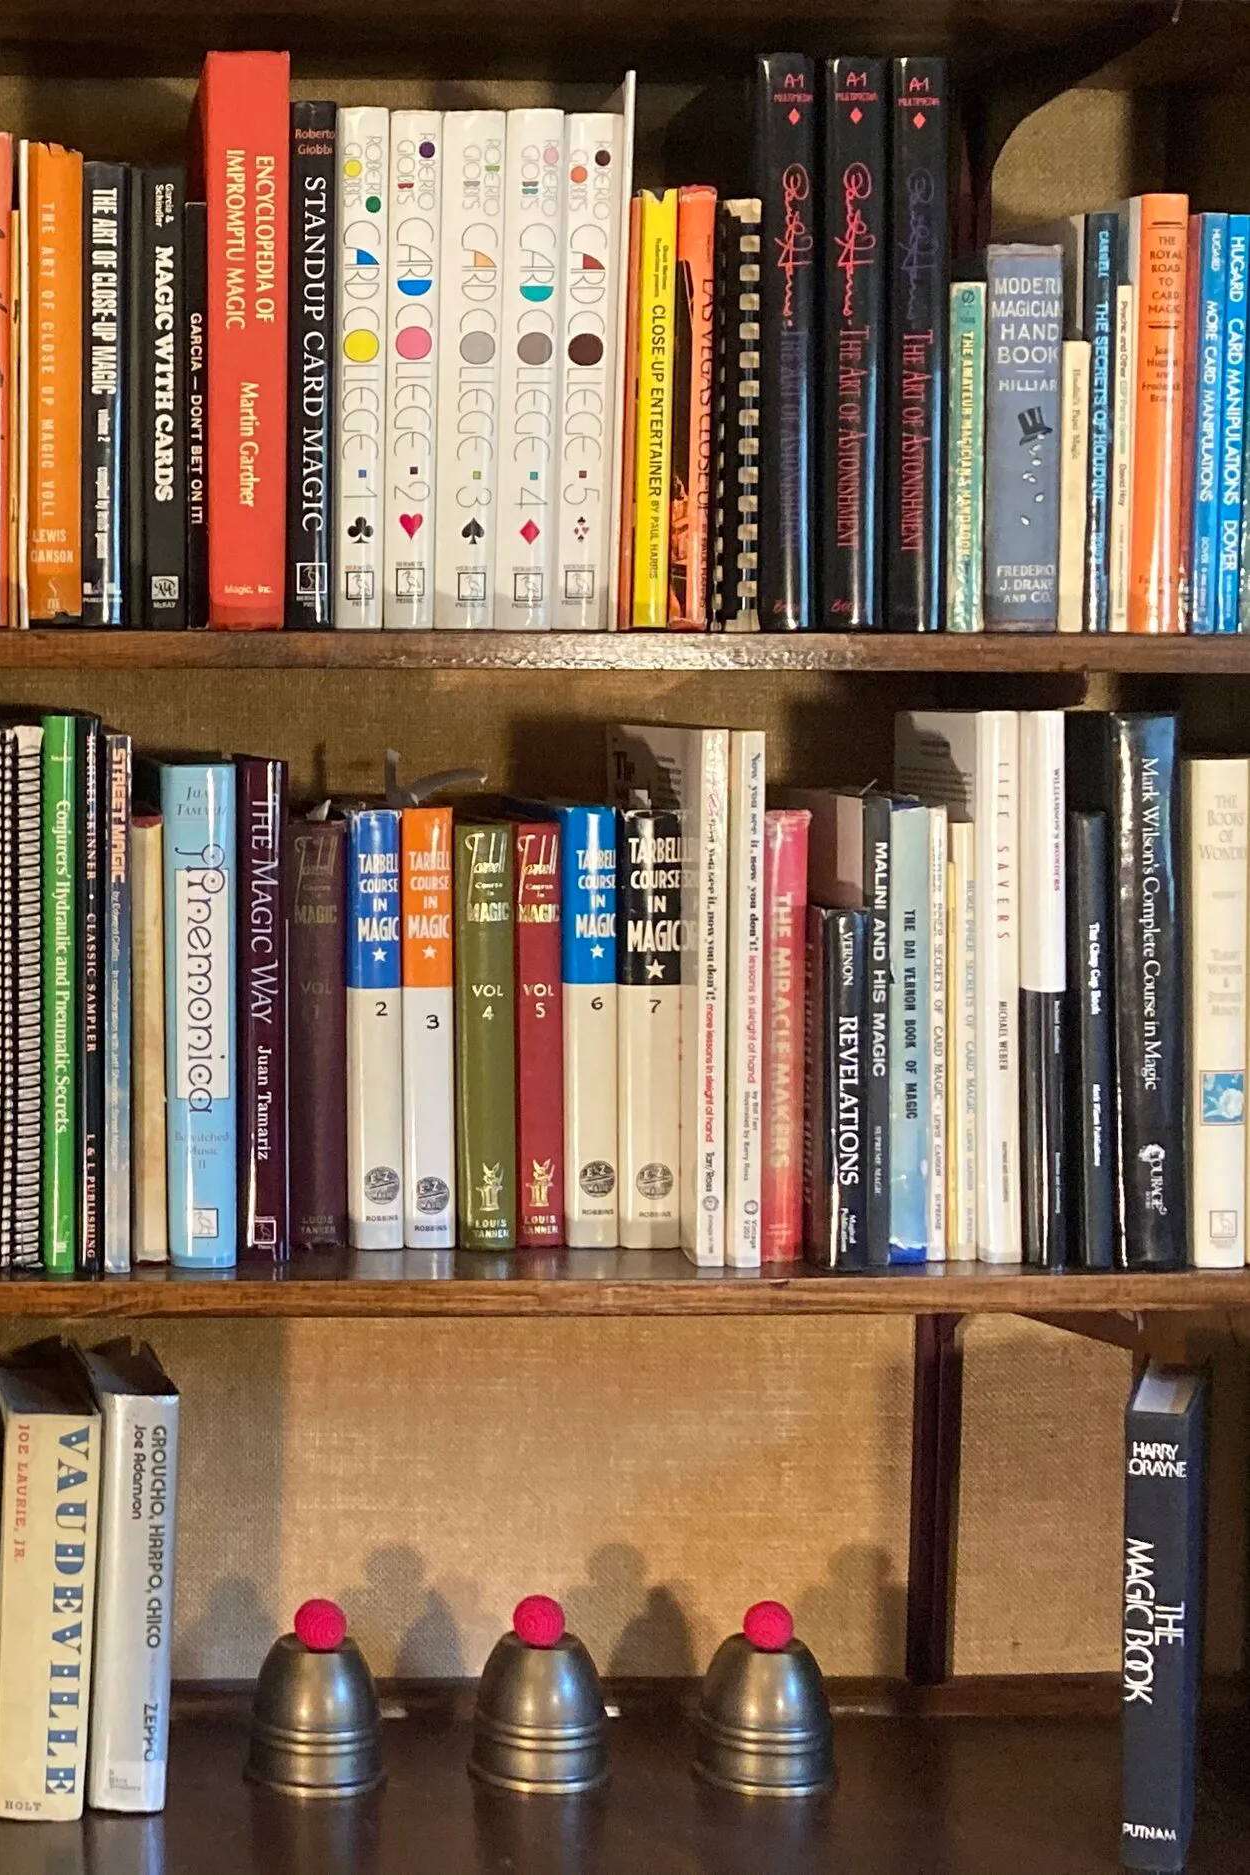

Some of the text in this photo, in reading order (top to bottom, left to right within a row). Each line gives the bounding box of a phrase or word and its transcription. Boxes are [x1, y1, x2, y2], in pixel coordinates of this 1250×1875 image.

[224, 149, 245, 330] IMPROMPTU MAGIC
[254, 156, 275, 323] ENCYCLOPEDIA OF
[153, 246, 175, 502] MAGIC WITH CARDS
[190, 313, 203, 371] GARCIA
[301, 175, 326, 532] STANDUP CARD MAGIC
[395, 218, 435, 456] CARD COLLEGE
[647, 304, 667, 498] CLOSE-UP ENTERTAINER
[1222, 236, 1244, 571] HUGARD CARD MANIPULATIONS DOVER
[190, 394, 203, 525] DON'T BET ON IT!
[239, 382, 260, 506] Martin Gardner
[249, 795, 279, 1024] THE MAGIC WAY
[358, 854, 399, 873] TARBELL
[358, 917, 399, 941] MAGIC
[360, 879, 398, 892] COURSE
[373, 899, 387, 912] IN
[1137, 758, 1162, 1090] Mark Wilson's Complete Course in Magic
[175, 844, 227, 1114] Mnemonica
[871, 841, 888, 1078] MALINI AND HIS MAGIC
[837, 1015, 859, 1186] REVELATIONS
[1132, 1440, 1179, 1461] HARRY
[44, 1425, 91, 1796] VAUDEVILLE
[143, 1424, 168, 1762] GROUCHO, HARPO, CHICO ZEPPO
[1124, 1539, 1154, 1704] MAGIC BOOK
[1154, 1601, 1185, 1647] THE
[1122, 1823, 1177, 1841] PUTNAM
